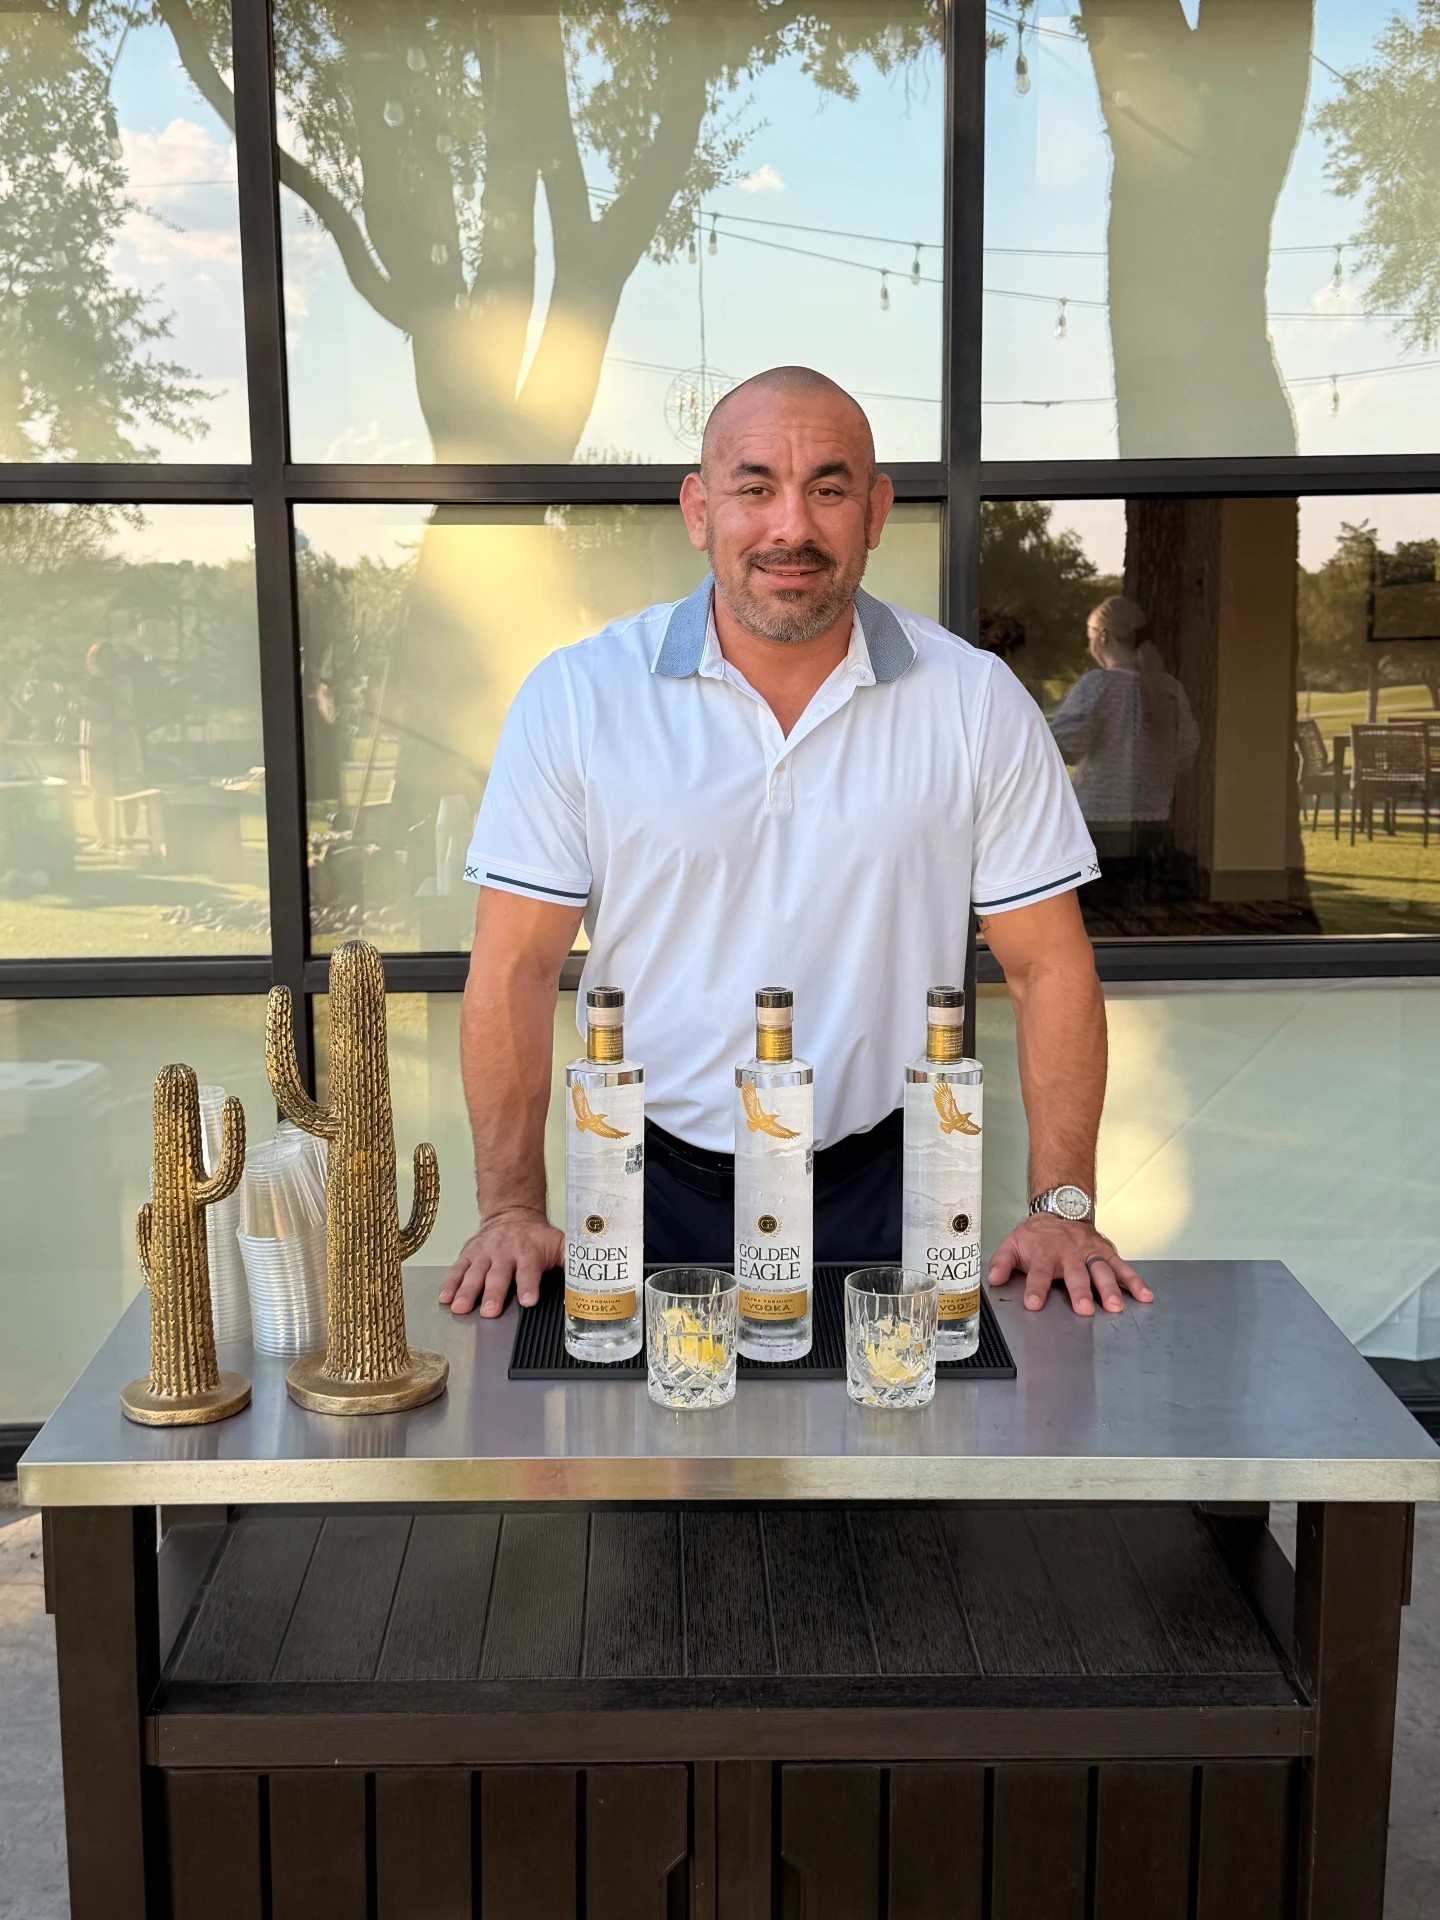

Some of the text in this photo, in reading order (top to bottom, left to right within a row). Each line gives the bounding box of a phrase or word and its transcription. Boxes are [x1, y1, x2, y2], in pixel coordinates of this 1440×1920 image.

[568, 1243, 628, 1262] GOLDEN
[739, 1243, 801, 1261] GOLDEN
[568, 1258, 629, 1282] EAGLE
[739, 1258, 801, 1281] EAGLE
[575, 1302, 617, 1312] VODKA
[748, 1302, 791, 1312] VODKA
[938, 1300, 976, 1312] VODKA
